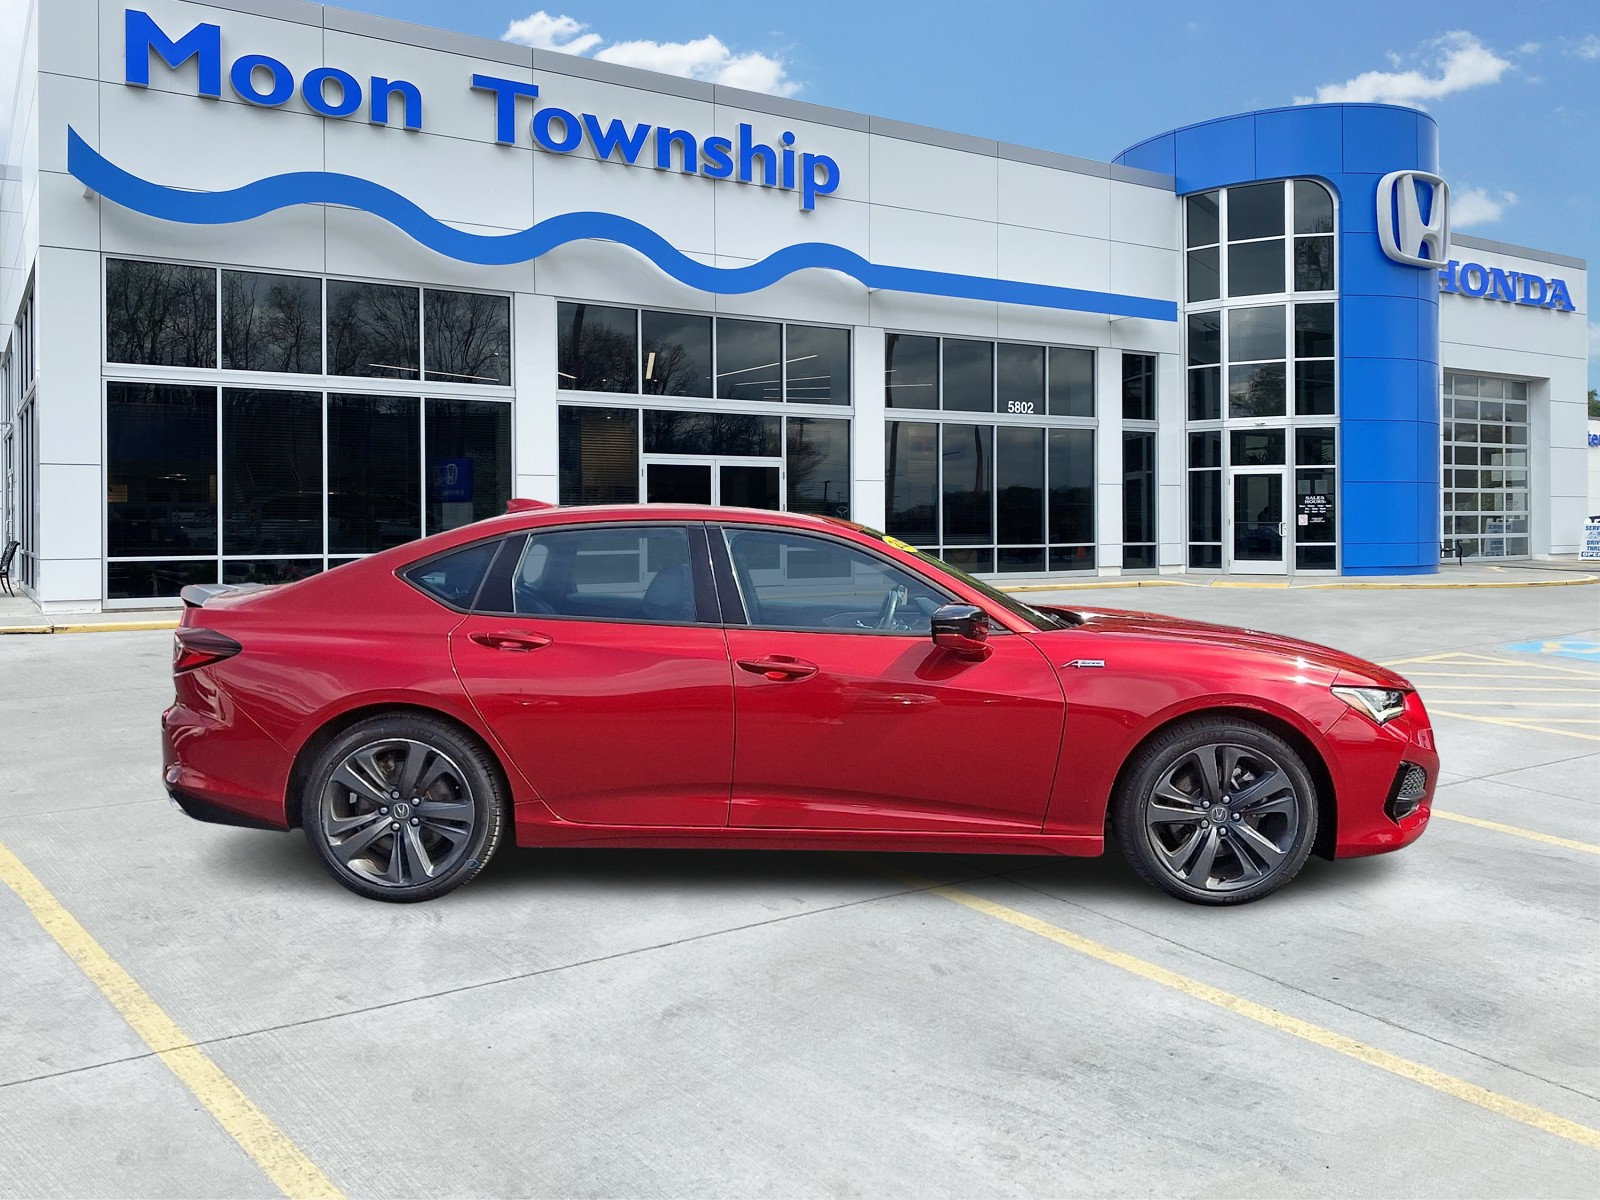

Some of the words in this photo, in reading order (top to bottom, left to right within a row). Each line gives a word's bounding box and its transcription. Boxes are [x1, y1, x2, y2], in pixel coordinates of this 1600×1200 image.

[125, 9, 423, 132] Moon
[470, 73, 842, 212] Township
[1007, 400, 1034, 414] 5802
